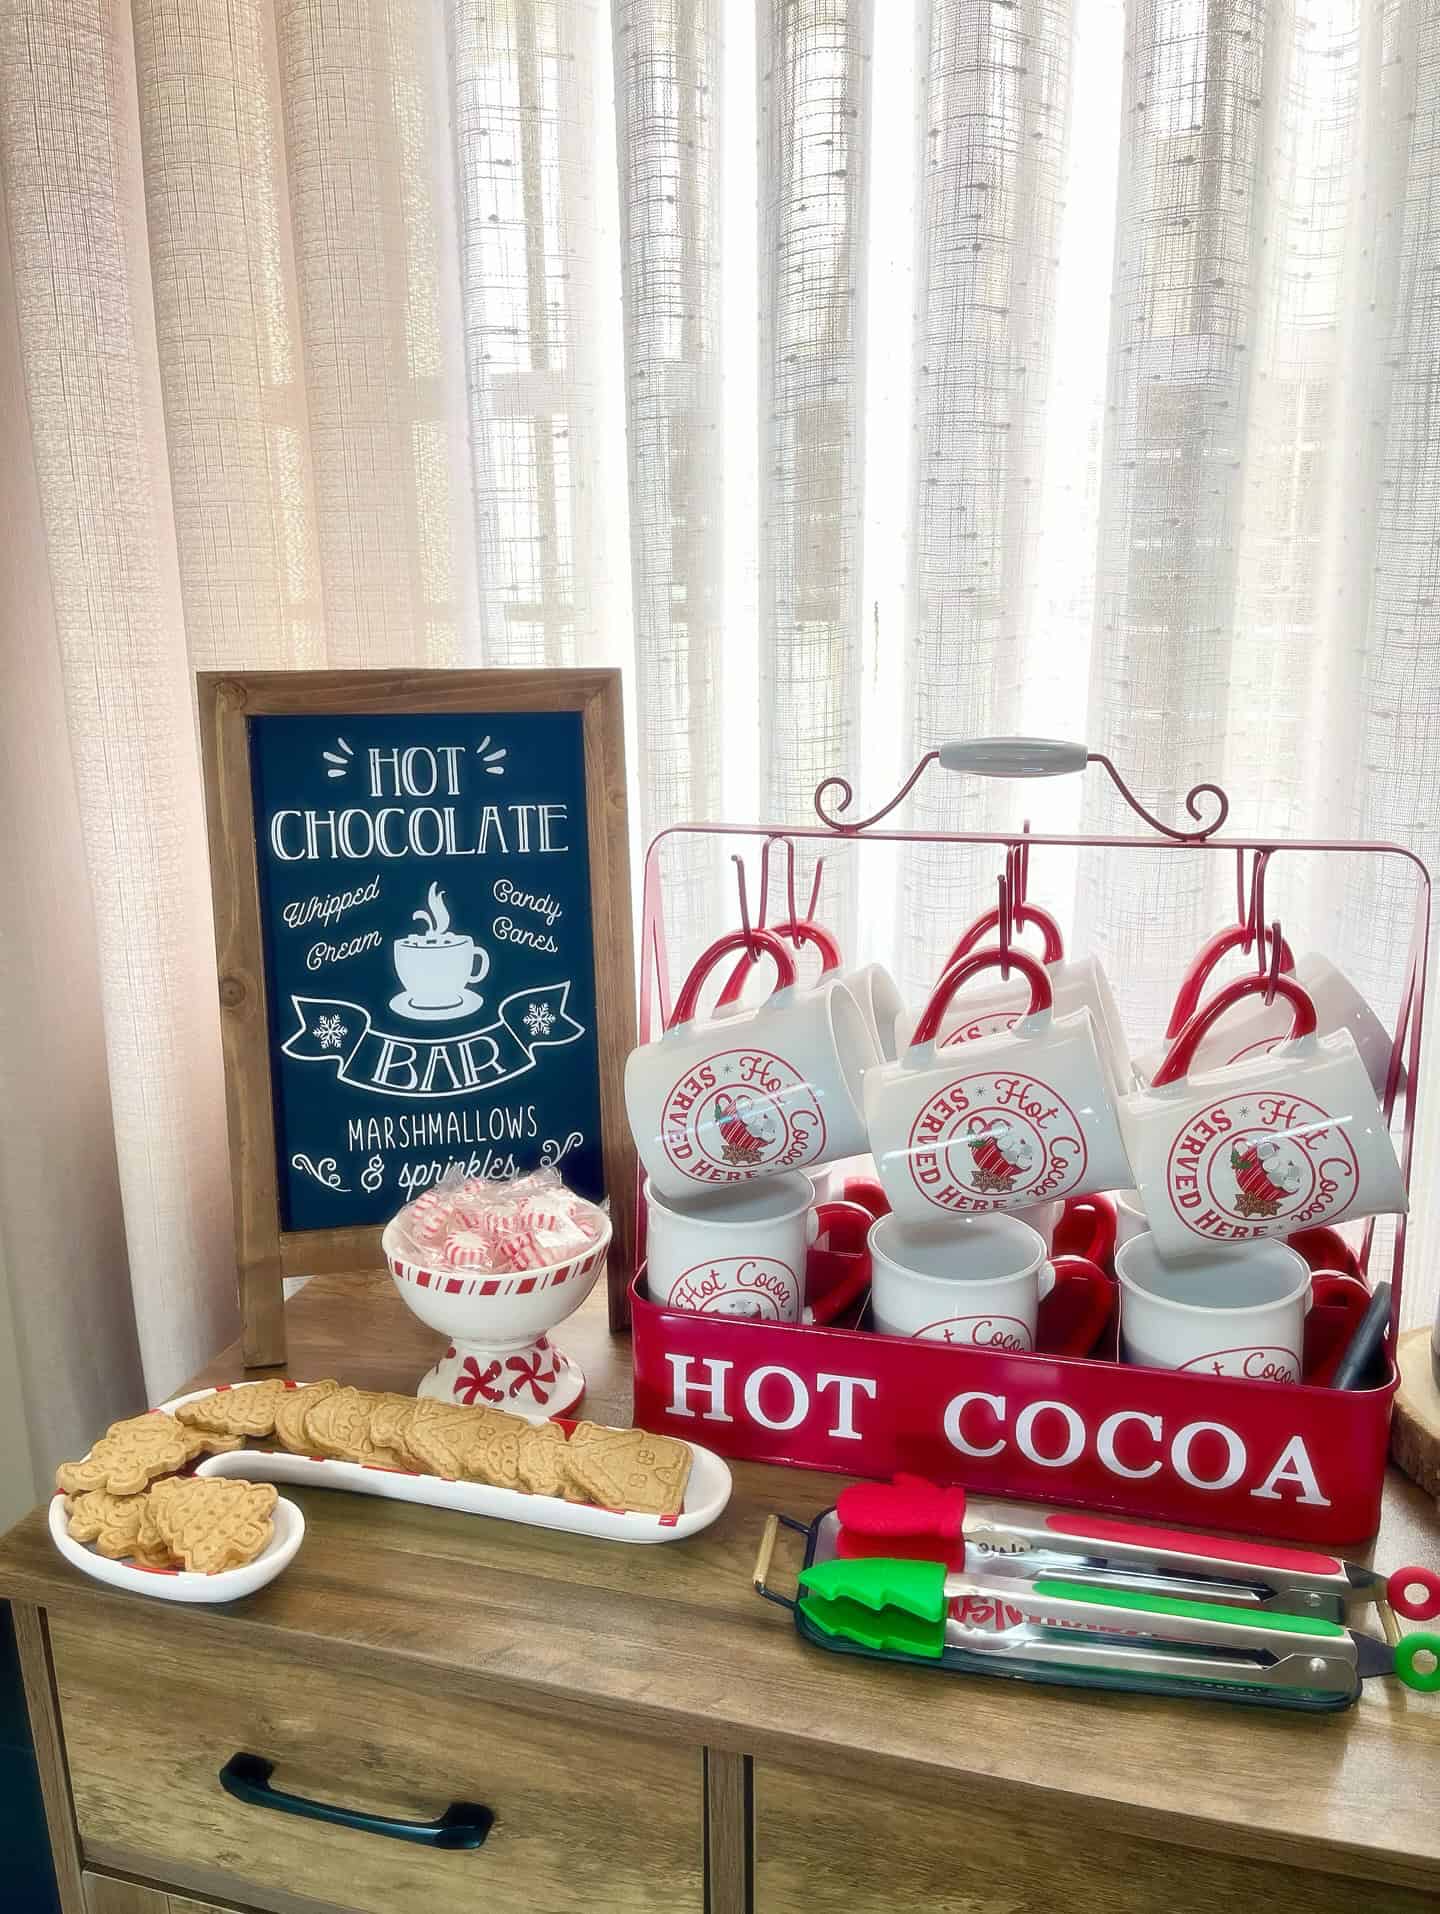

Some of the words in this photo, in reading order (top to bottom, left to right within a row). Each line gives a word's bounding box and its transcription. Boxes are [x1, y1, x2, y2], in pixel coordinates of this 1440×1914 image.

[368, 747, 465, 797] HOT
[270, 804, 569, 860] CHOCOLATE
[283, 875, 381, 928] Whipped
[493, 879, 562, 925] Candy
[306, 930, 382, 970] Cream
[492, 916, 558, 952] Canes
[371, 1036, 506, 1091] BAR
[348, 1105, 537, 1151] MARSHMALLOWS
[668, 1066, 717, 1160] SERVED
[994, 1078, 1059, 1130] Hot
[775, 1110, 818, 1165] Cocoa
[1175, 1108, 1233, 1209] SERVED
[360, 1154, 385, 1193] &
[1026, 1136, 1081, 1197] Cocoa
[1290, 1157, 1353, 1223] Cocoa
[934, 1185, 1008, 1211] HERE
[1193, 1208, 1269, 1238] HERE
[675, 1269, 727, 1312] Hot
[736, 1261, 791, 1308] Cocoa
[972, 1320, 1025, 1352] Coco
[1243, 1352, 1296, 1385] Coco
[664, 1353, 877, 1440] HOT
[943, 1391, 1332, 1507] COCOA
